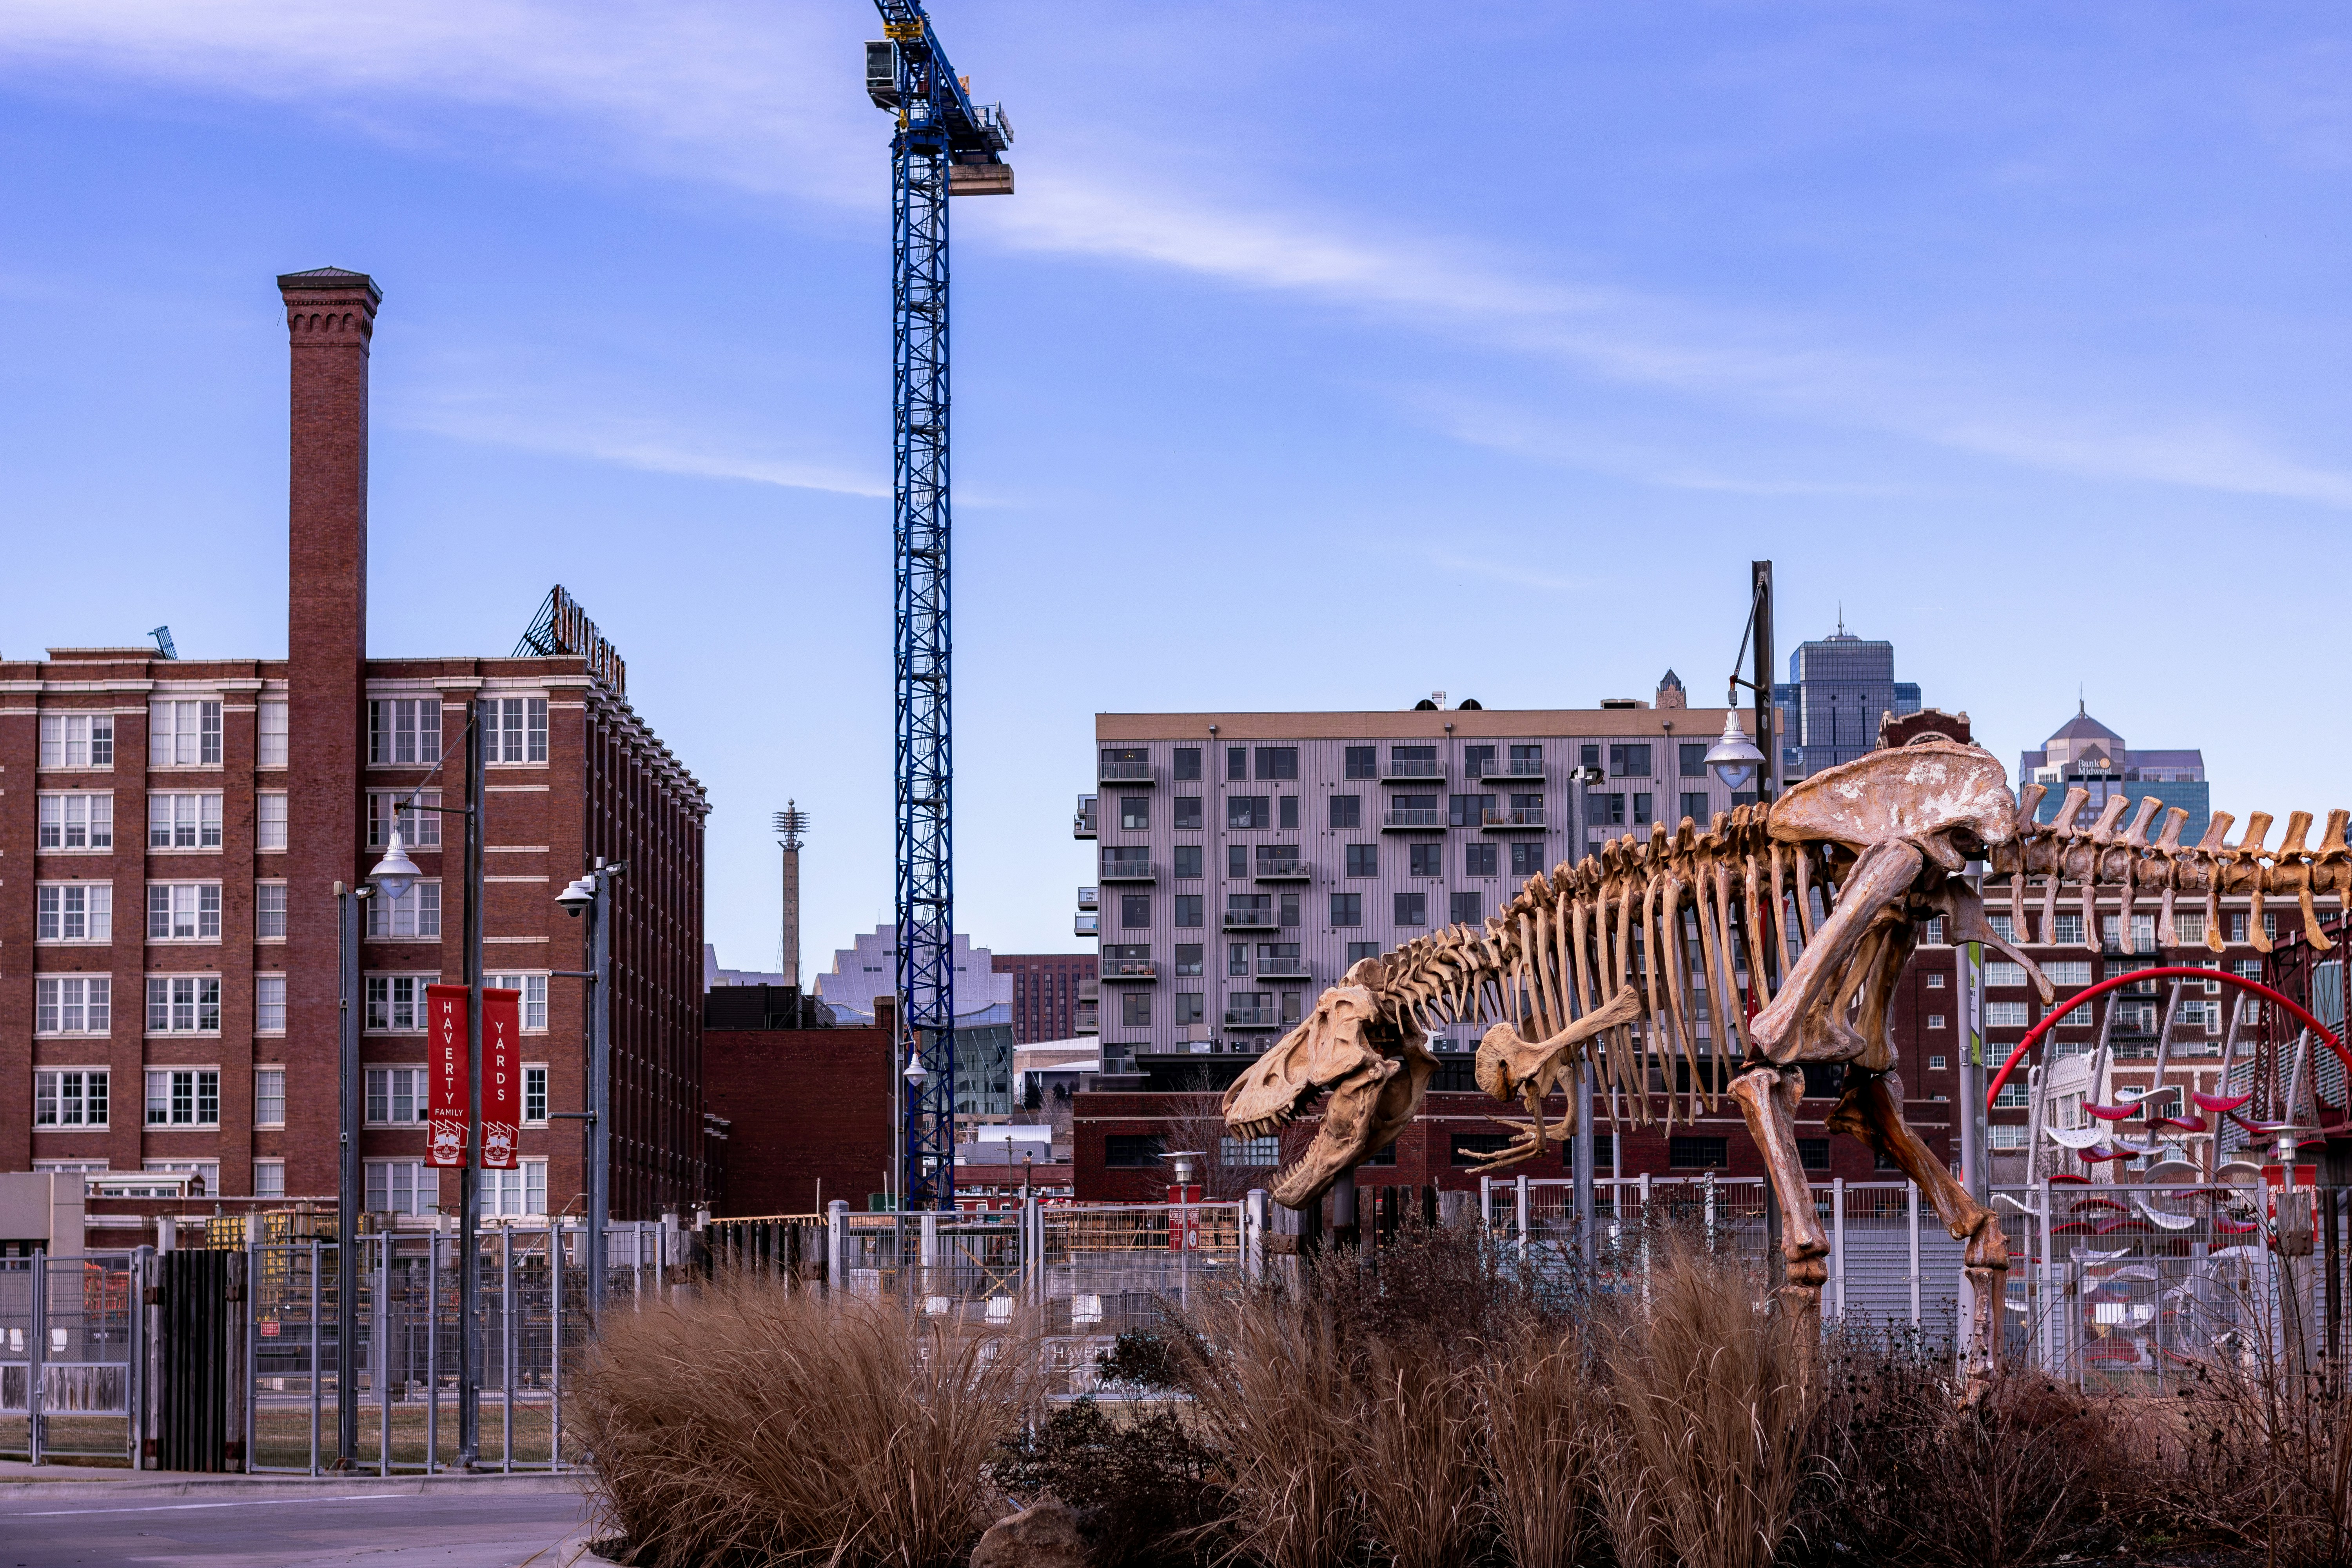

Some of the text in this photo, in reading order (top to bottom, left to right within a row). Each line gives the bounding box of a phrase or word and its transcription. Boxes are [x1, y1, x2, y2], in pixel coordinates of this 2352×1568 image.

[2078, 759, 2100, 767] Bank
[2079, 767, 2112, 775] Midwest
[443, 1002, 454, 1104] HAVERTY
[495, 1022, 505, 1101] YARDS
[2267, 1185, 2284, 1194] IMPLE
[1053, 1346, 1114, 1358] HAVERT
[1093, 1378, 1143, 1390] YAR
